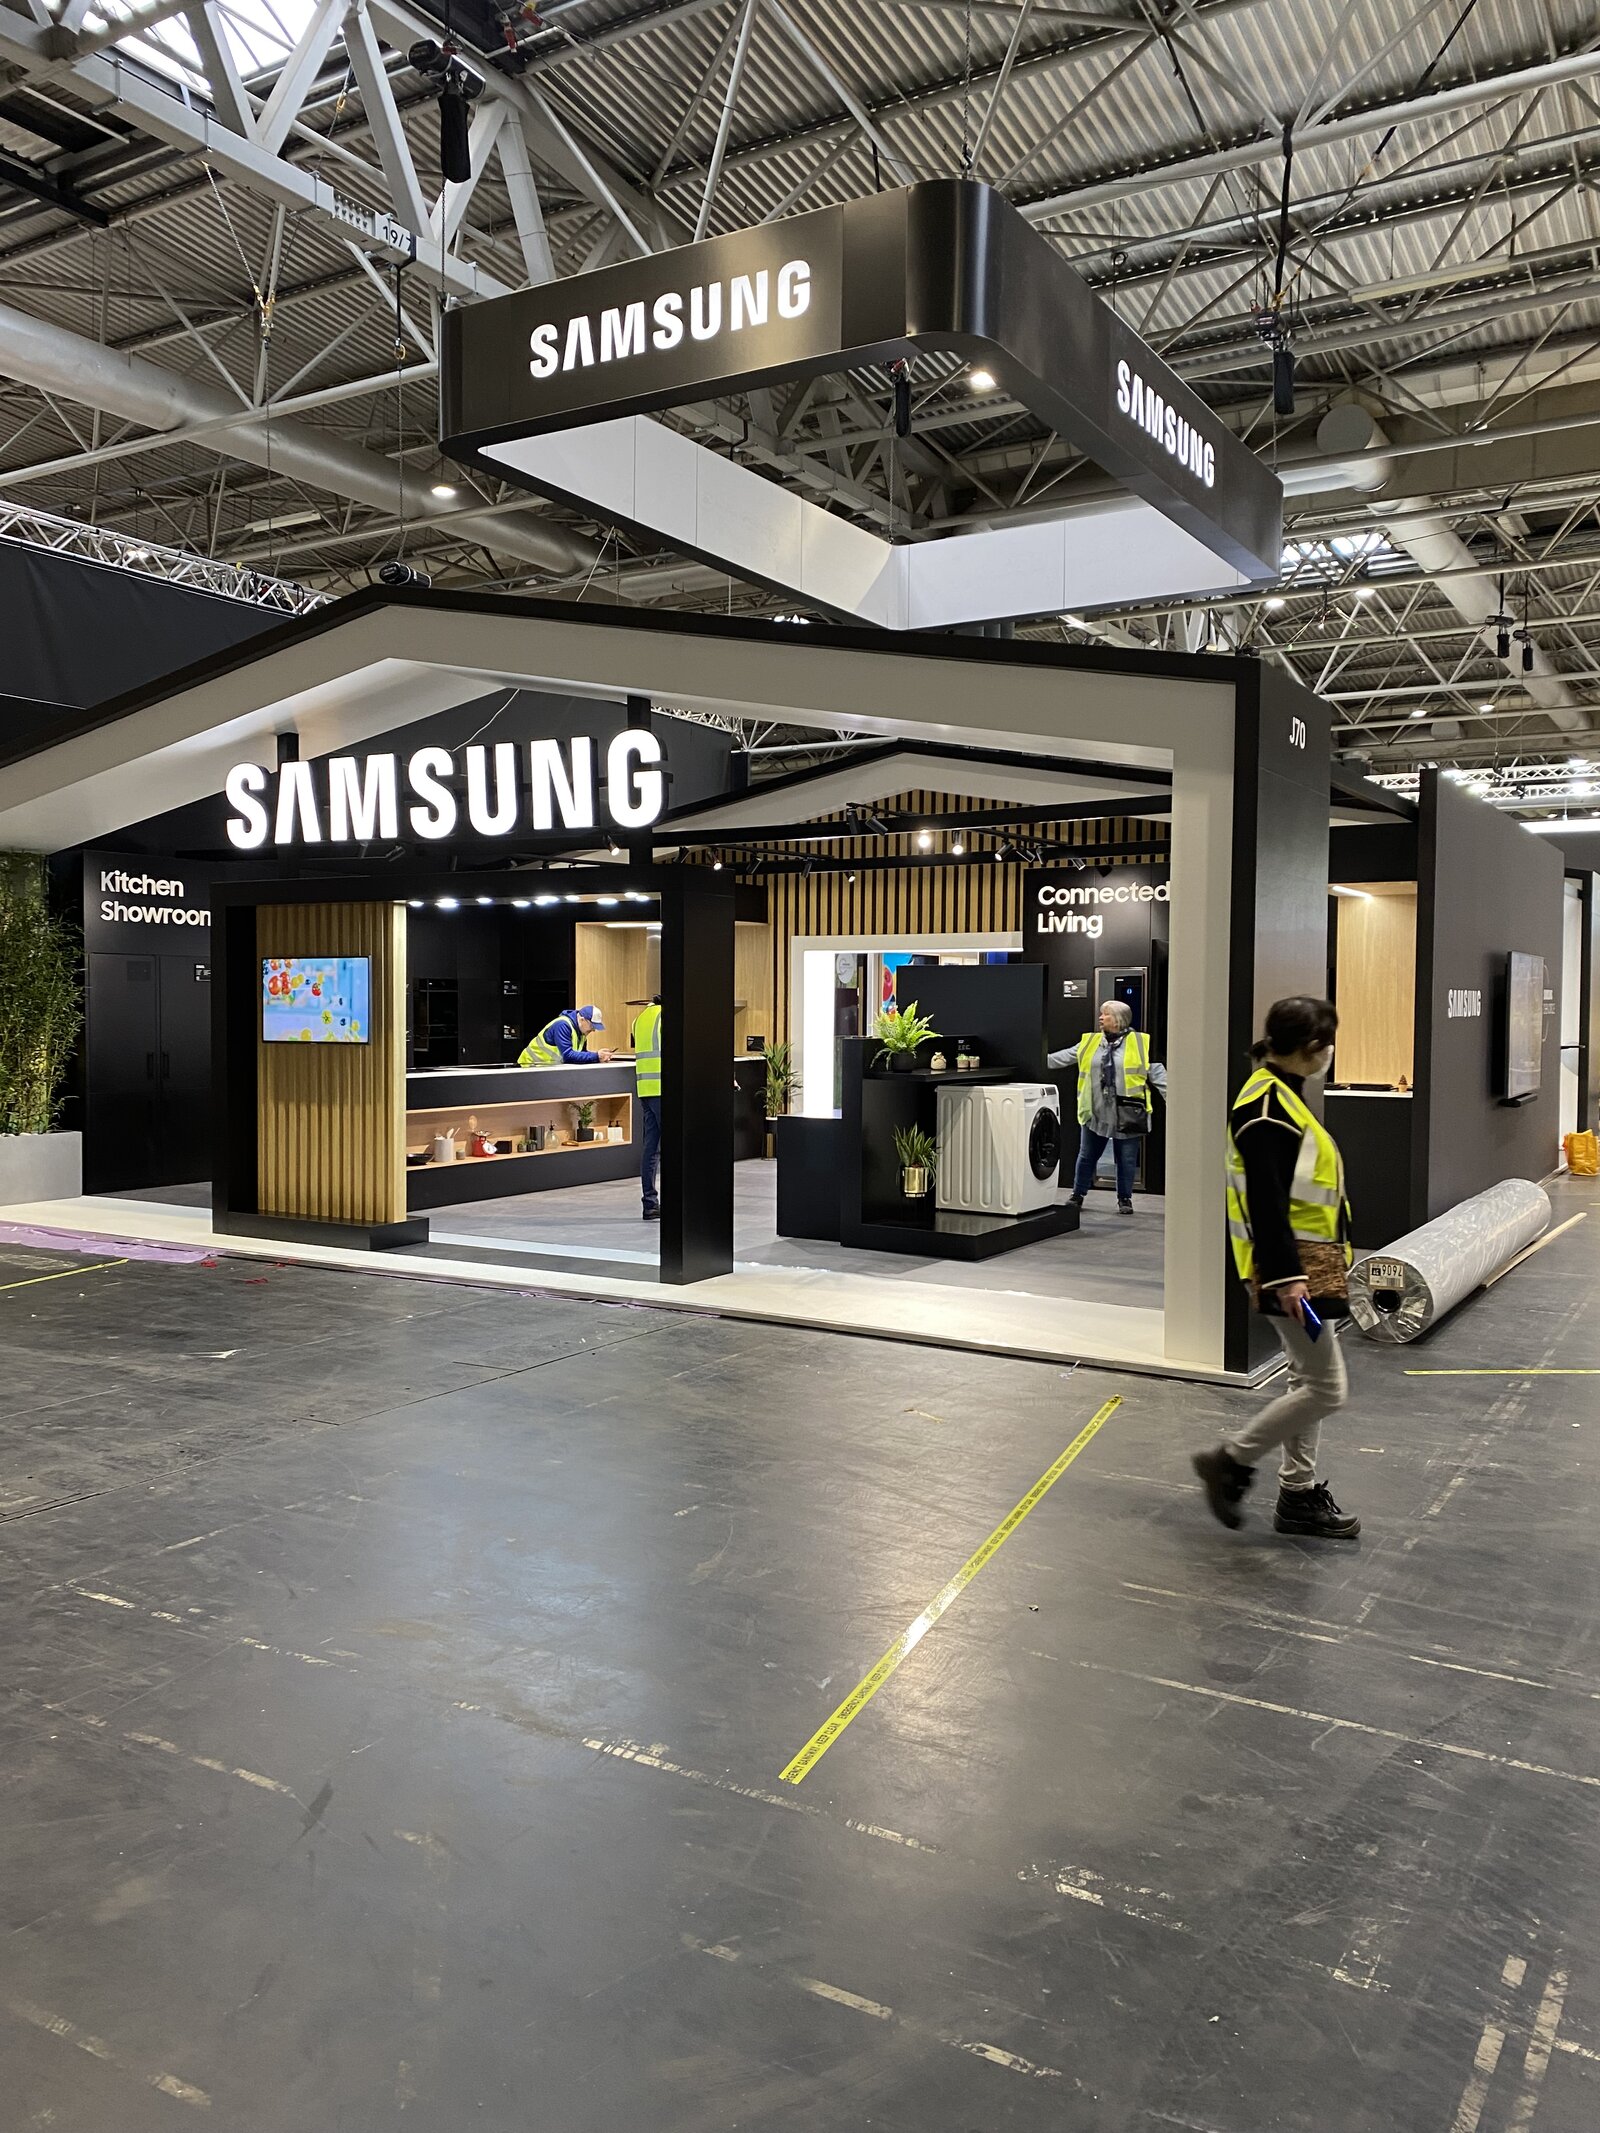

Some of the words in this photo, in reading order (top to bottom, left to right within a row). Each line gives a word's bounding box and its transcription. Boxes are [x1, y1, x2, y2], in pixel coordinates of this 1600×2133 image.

[529, 260, 811, 379] SAMSUNG
[1117, 359, 1215, 488] SAMSUNG
[1289, 716, 1306, 750] J70
[225, 729, 668, 849] SAMSUNG
[100, 869, 185, 898] Kitchen
[1037, 881, 1171, 906] Connected
[1037, 910, 1104, 939] Living
[1447, 988, 1482, 1019] SAMSUNG
